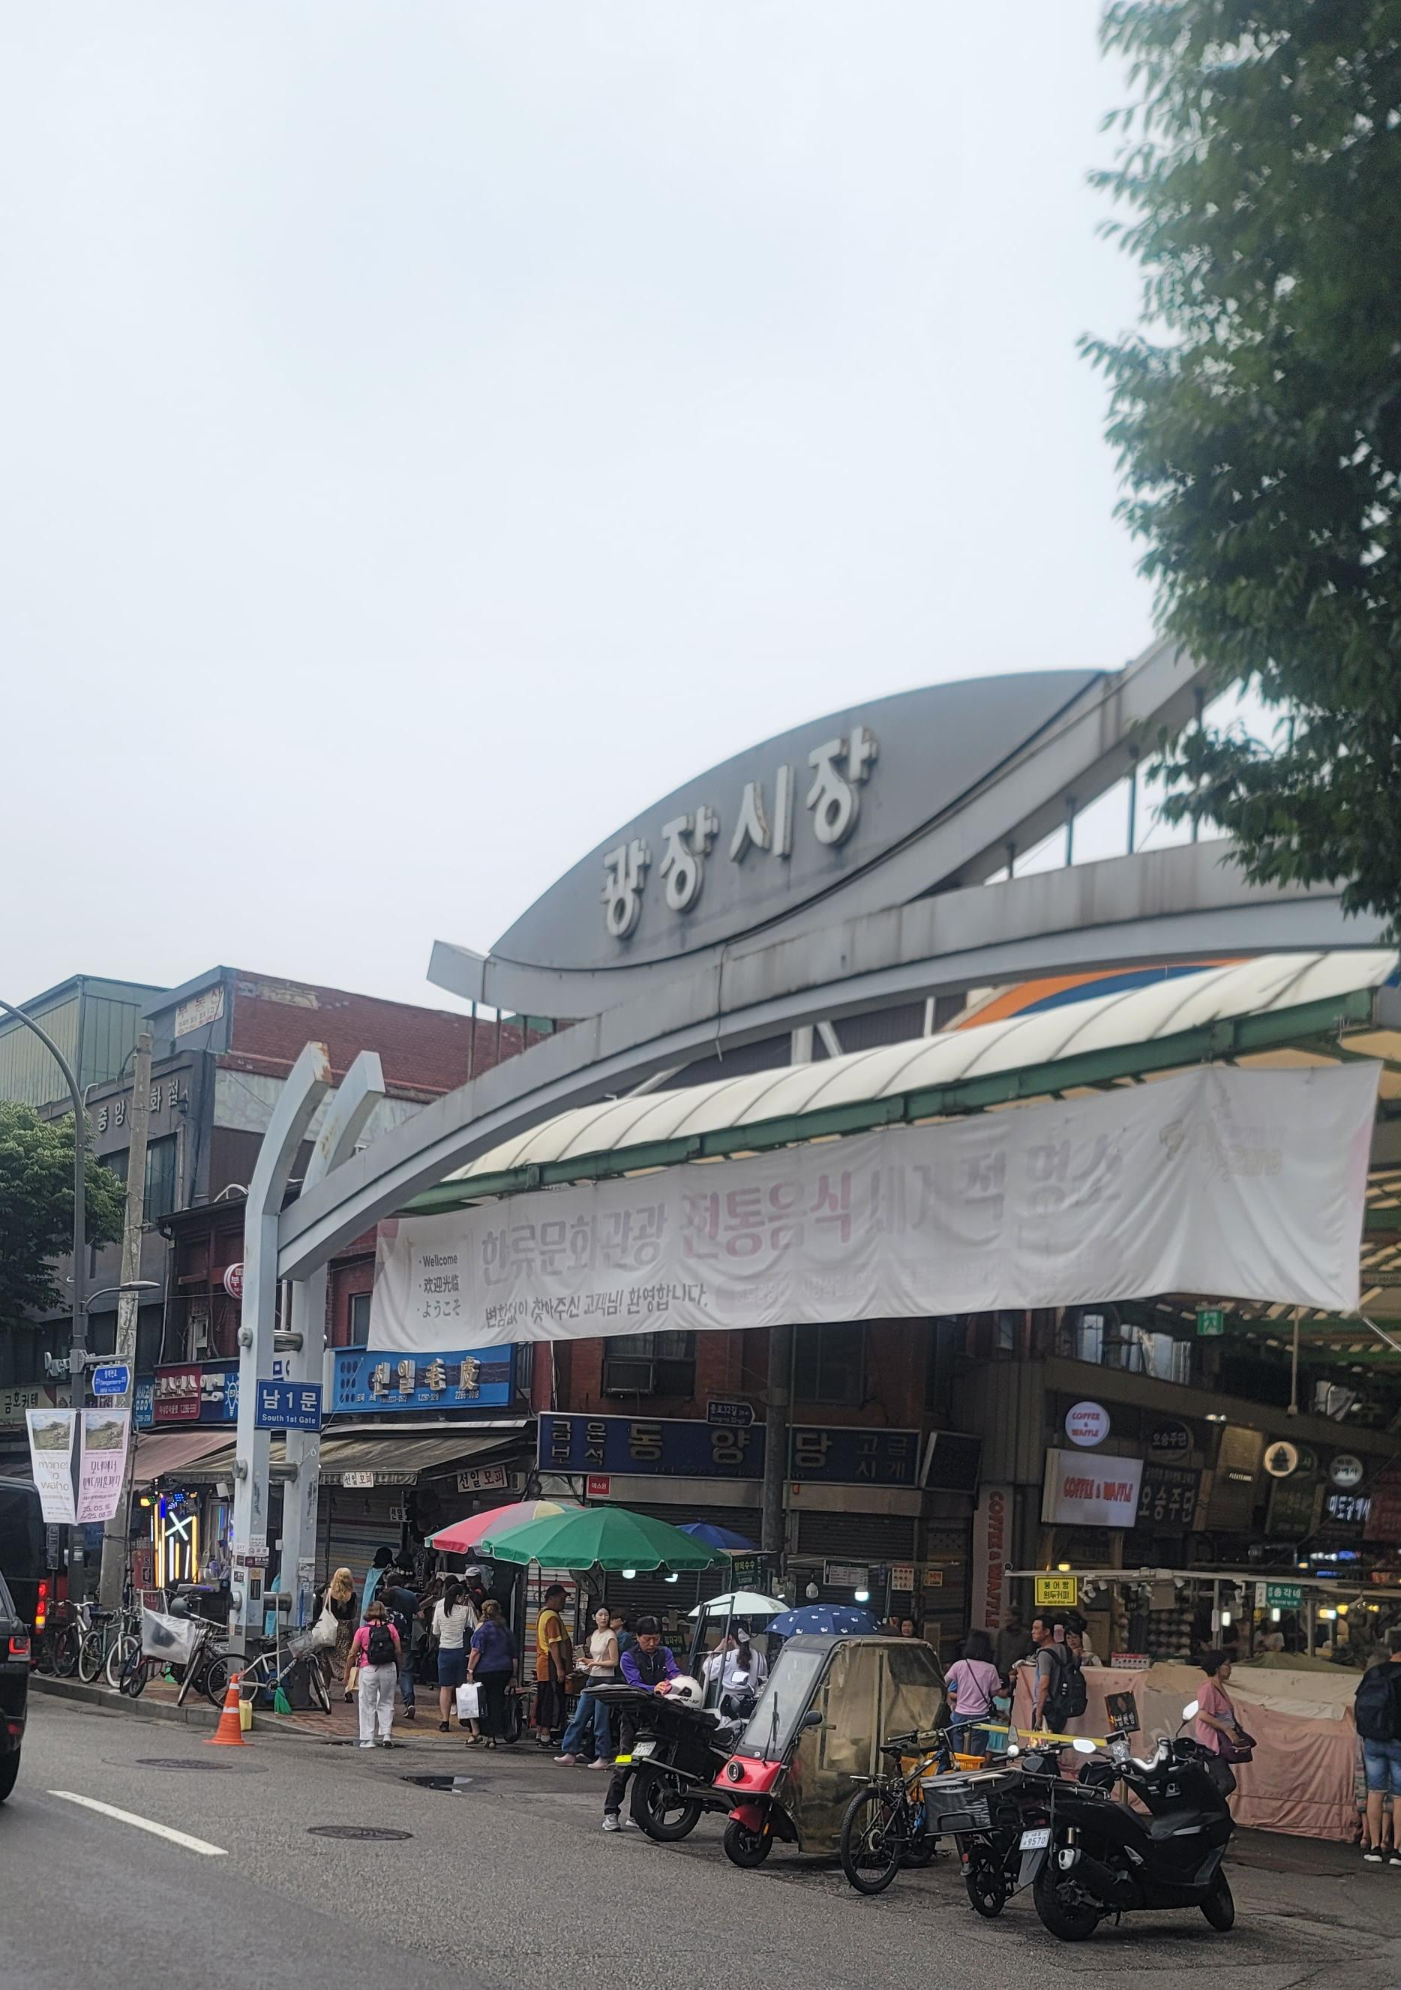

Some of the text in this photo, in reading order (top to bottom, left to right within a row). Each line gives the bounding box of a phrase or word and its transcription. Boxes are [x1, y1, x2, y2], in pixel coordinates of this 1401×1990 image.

[600, 726, 880, 939] 광장시장
[681, 1170, 851, 1259] 전통음식
[423, 1254, 457, 1267] Wellcome
[424, 1275, 459, 1294] 欢迎光临
[422, 1300, 461, 1318] ようこそ
[532, 1297, 579, 1324] 찾아주신
[262, 1413, 316, 1424] South 1st Gate
[1072, 1412, 1100, 1420] COFFEE
[1064, 1476, 1095, 1499] COFFEE
[988, 1490, 1004, 1549] COFFEE
[985, 1562, 1002, 1629] WAFFLE
[1028, 1836, 1046, 1847] 9570
